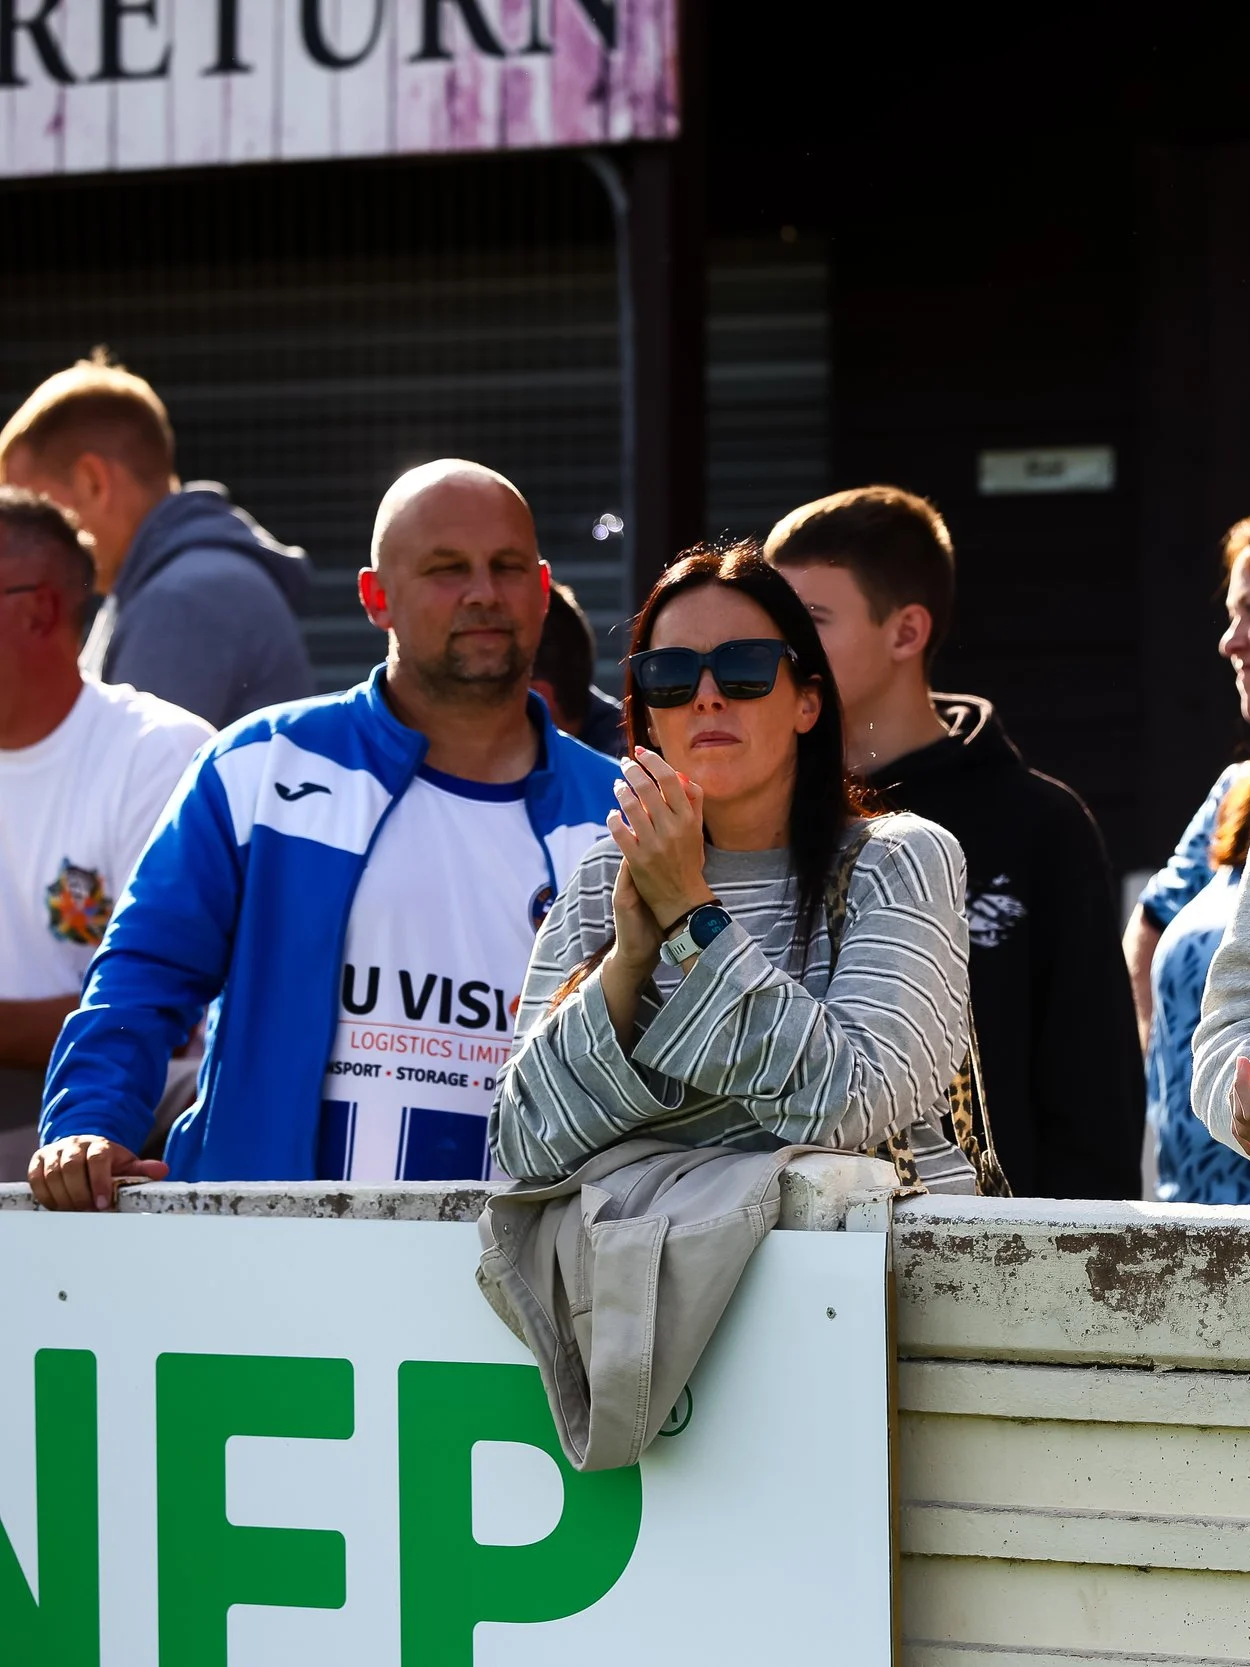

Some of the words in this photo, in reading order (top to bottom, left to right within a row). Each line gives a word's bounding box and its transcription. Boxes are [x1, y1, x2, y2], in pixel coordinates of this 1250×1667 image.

[398, 969, 521, 1032] VISI
[350, 1030, 453, 1059] LOGISTICS
[395, 1066, 469, 1088] STORAGE
